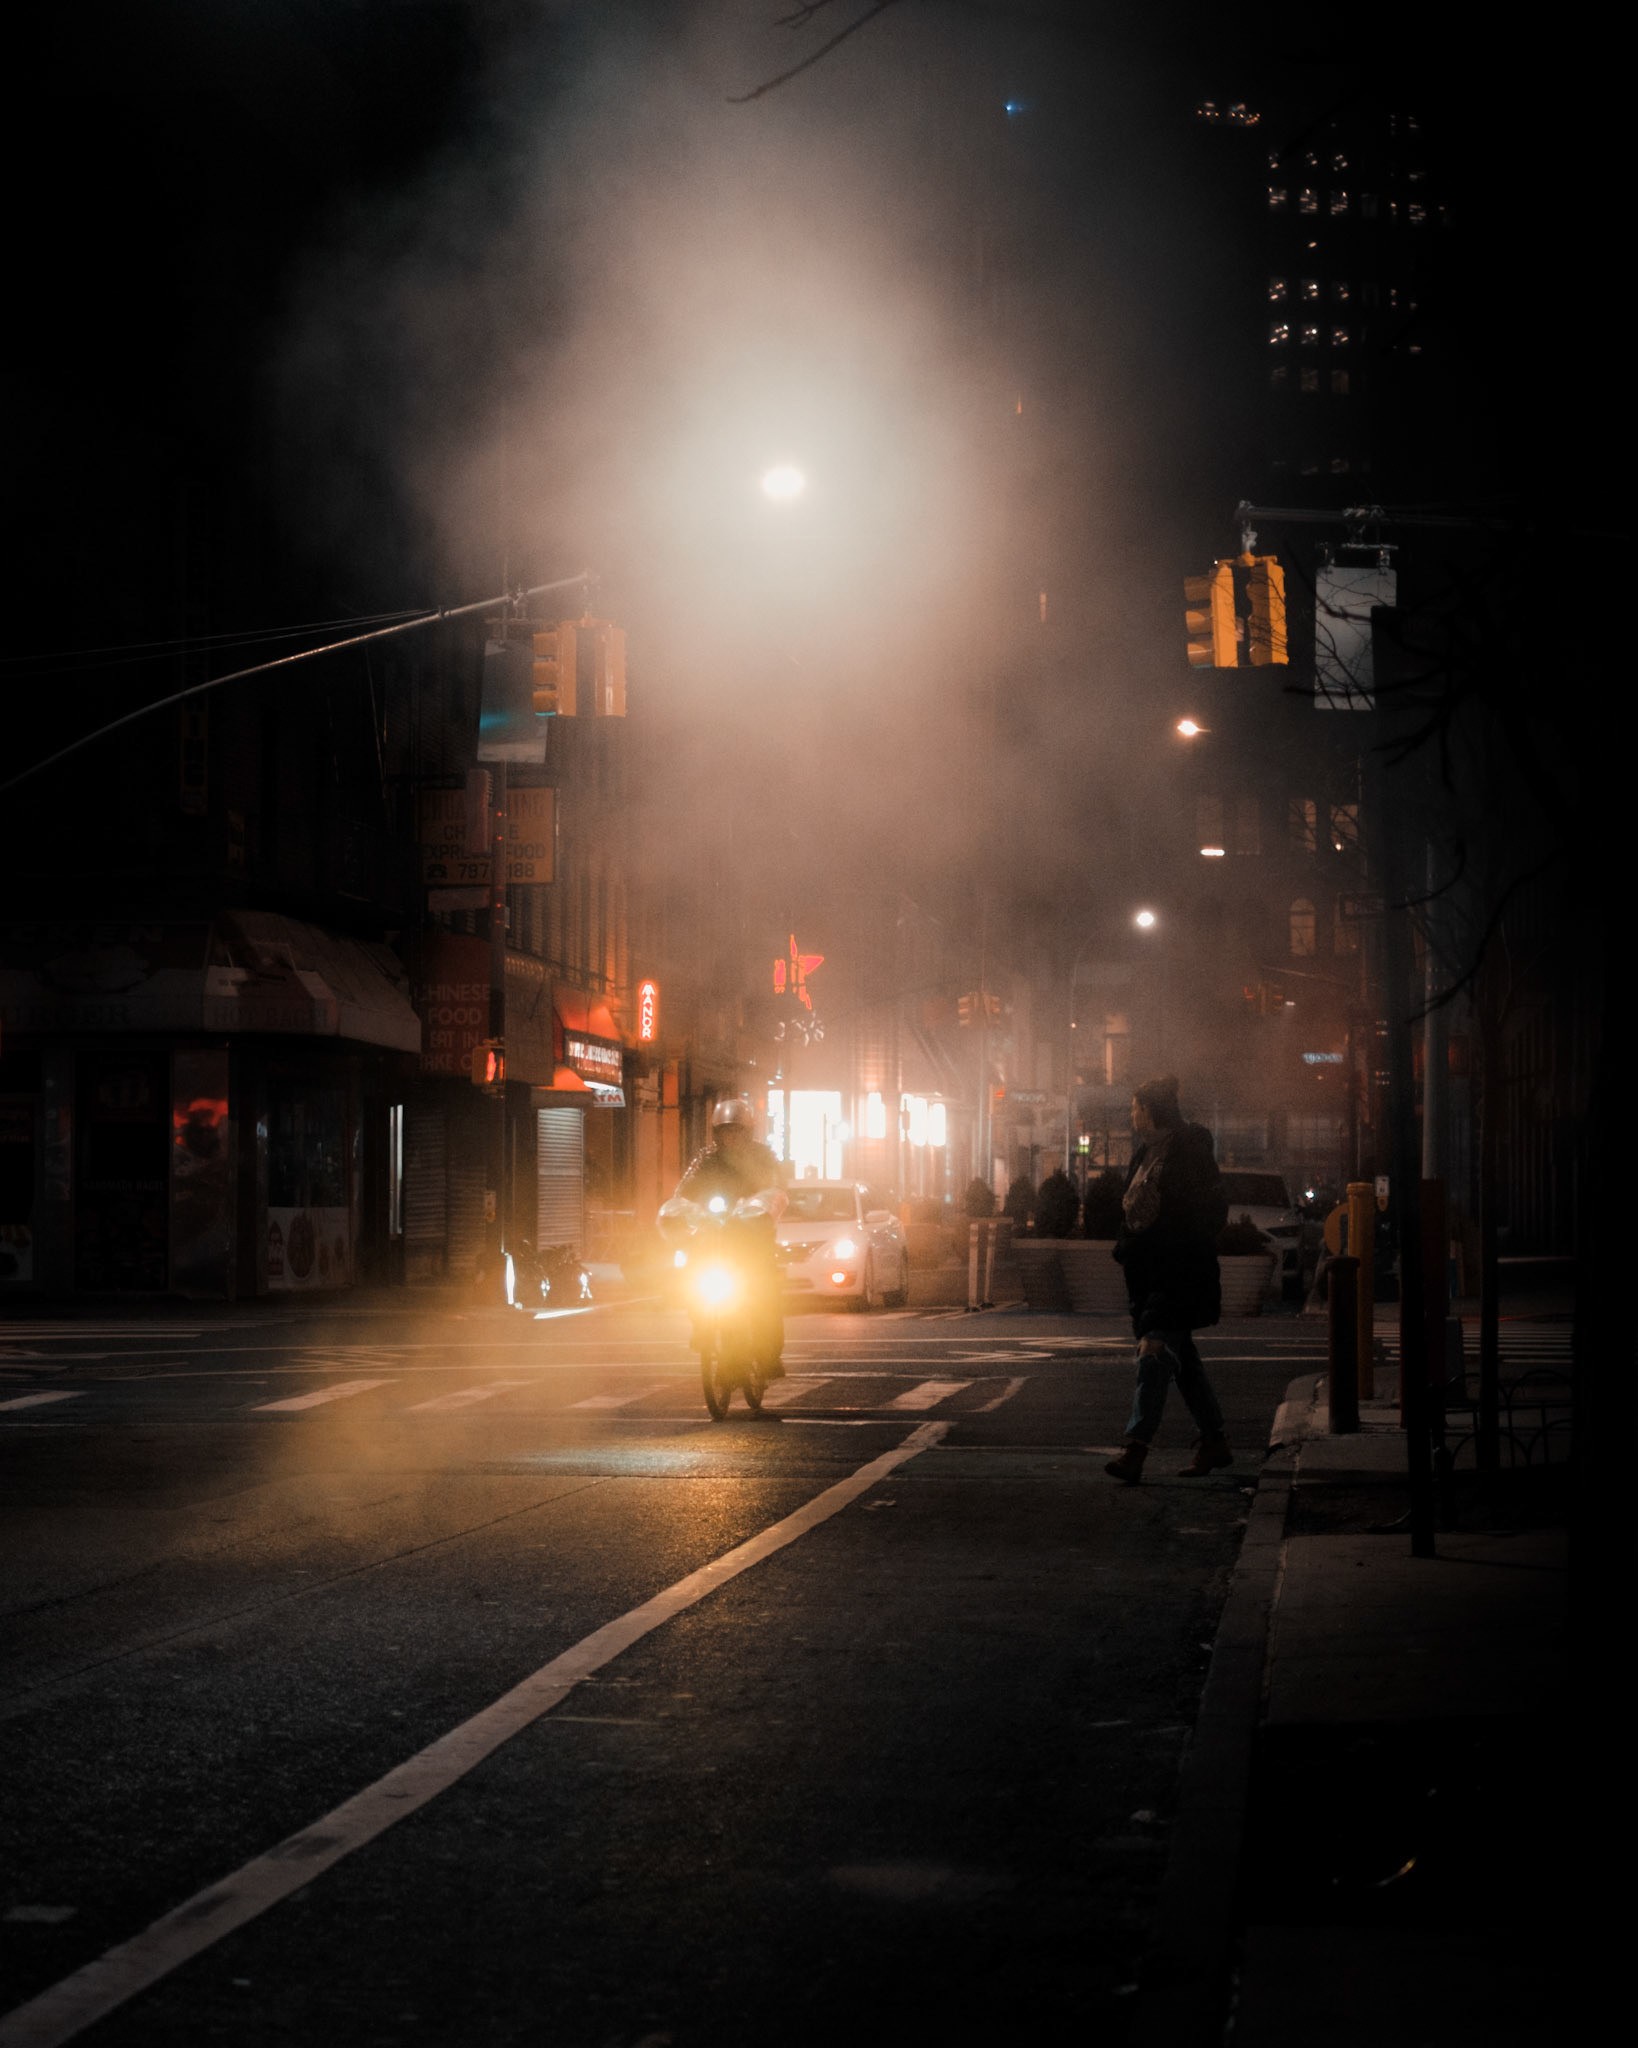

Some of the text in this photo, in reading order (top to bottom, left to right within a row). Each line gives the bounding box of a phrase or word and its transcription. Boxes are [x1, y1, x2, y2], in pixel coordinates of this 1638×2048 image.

[422, 843, 493, 860] EXPR
[508, 863, 535, 877] 188
[416, 984, 490, 1001] CHINESE
[428, 1007, 483, 1025] FOOD
[642, 985, 655, 1038] MANOR
[429, 1030, 479, 1048] EAT IN
